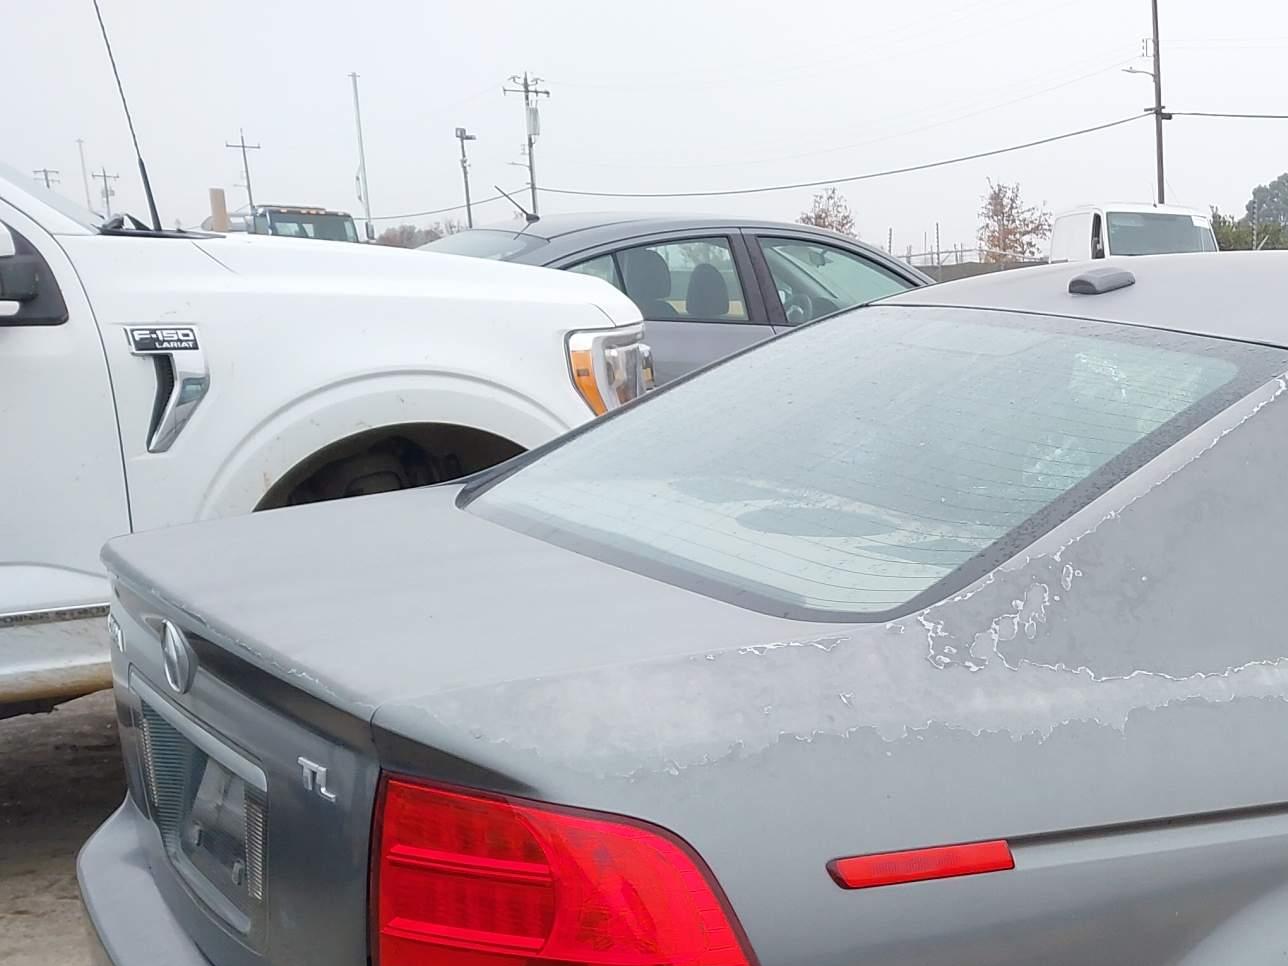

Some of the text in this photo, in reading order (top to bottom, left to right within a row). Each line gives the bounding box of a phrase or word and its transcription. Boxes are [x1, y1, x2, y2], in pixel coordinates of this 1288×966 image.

[132, 329, 195, 341] F-150
[155, 341, 193, 349] LARIAT
[297, 756, 336, 802] TL
